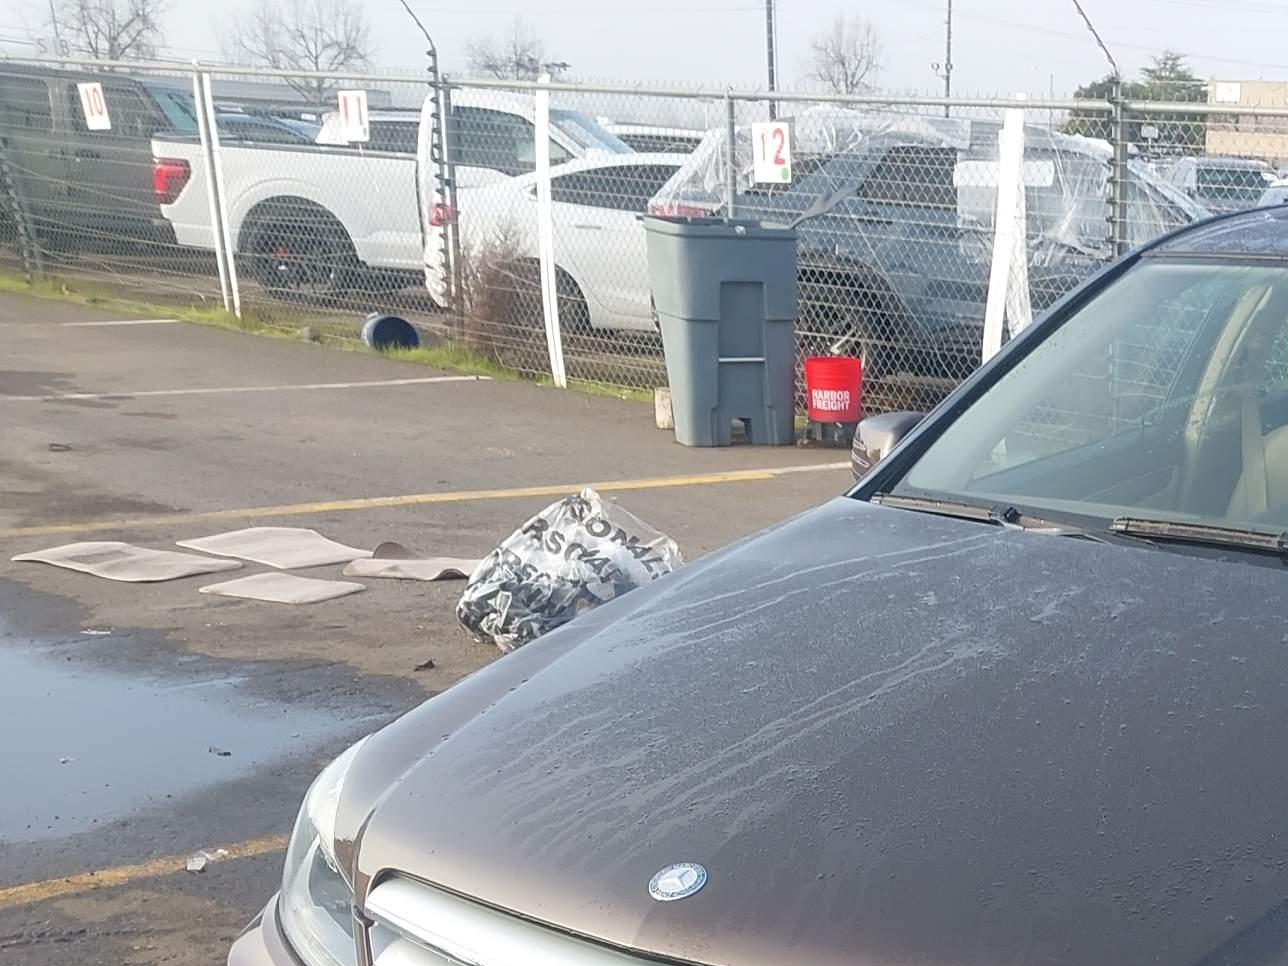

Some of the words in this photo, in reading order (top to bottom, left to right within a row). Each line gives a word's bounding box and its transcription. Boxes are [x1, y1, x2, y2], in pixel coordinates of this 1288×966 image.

[760, 127, 786, 165] 12
[811, 388, 851, 402] HARBOR
[812, 399, 850, 412] FREIGHT
